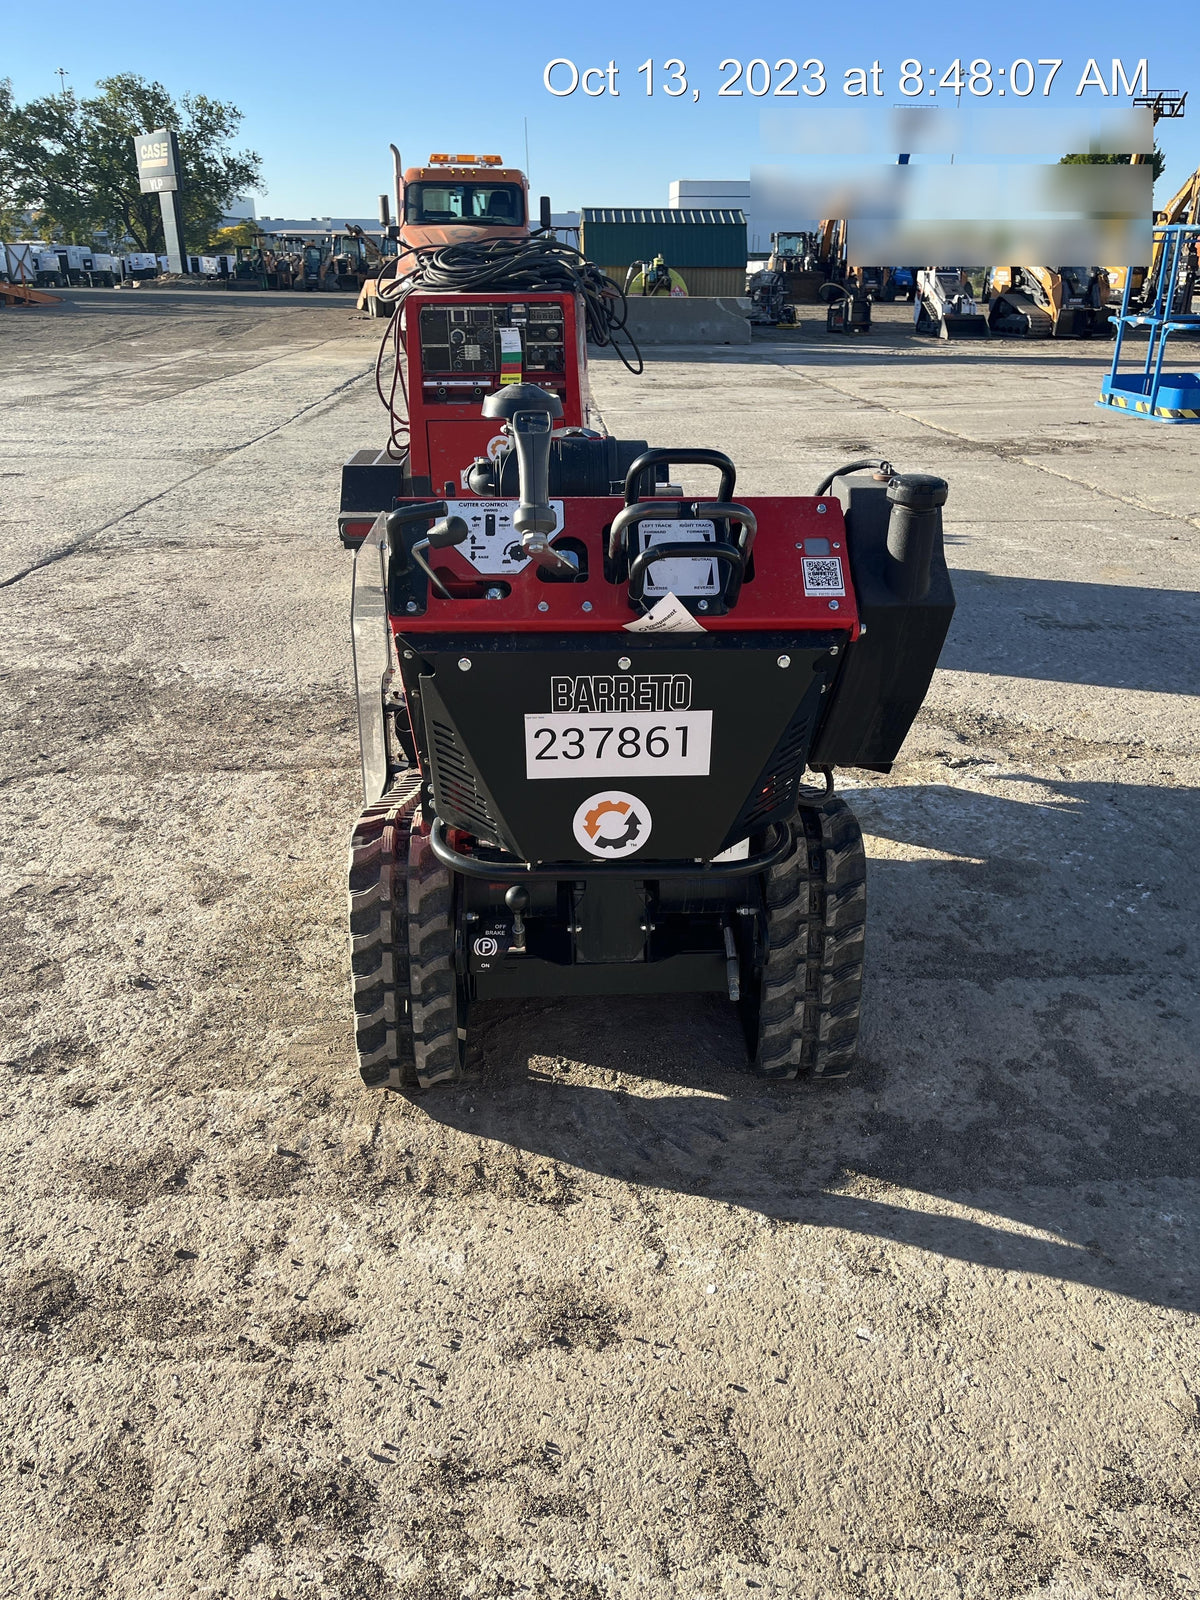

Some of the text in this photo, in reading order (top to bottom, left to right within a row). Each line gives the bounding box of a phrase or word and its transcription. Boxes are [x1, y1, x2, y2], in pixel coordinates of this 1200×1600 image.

[140, 143, 168, 160] CASE
[550, 674, 692, 713] BARRETO
[533, 725, 690, 761] 237861
